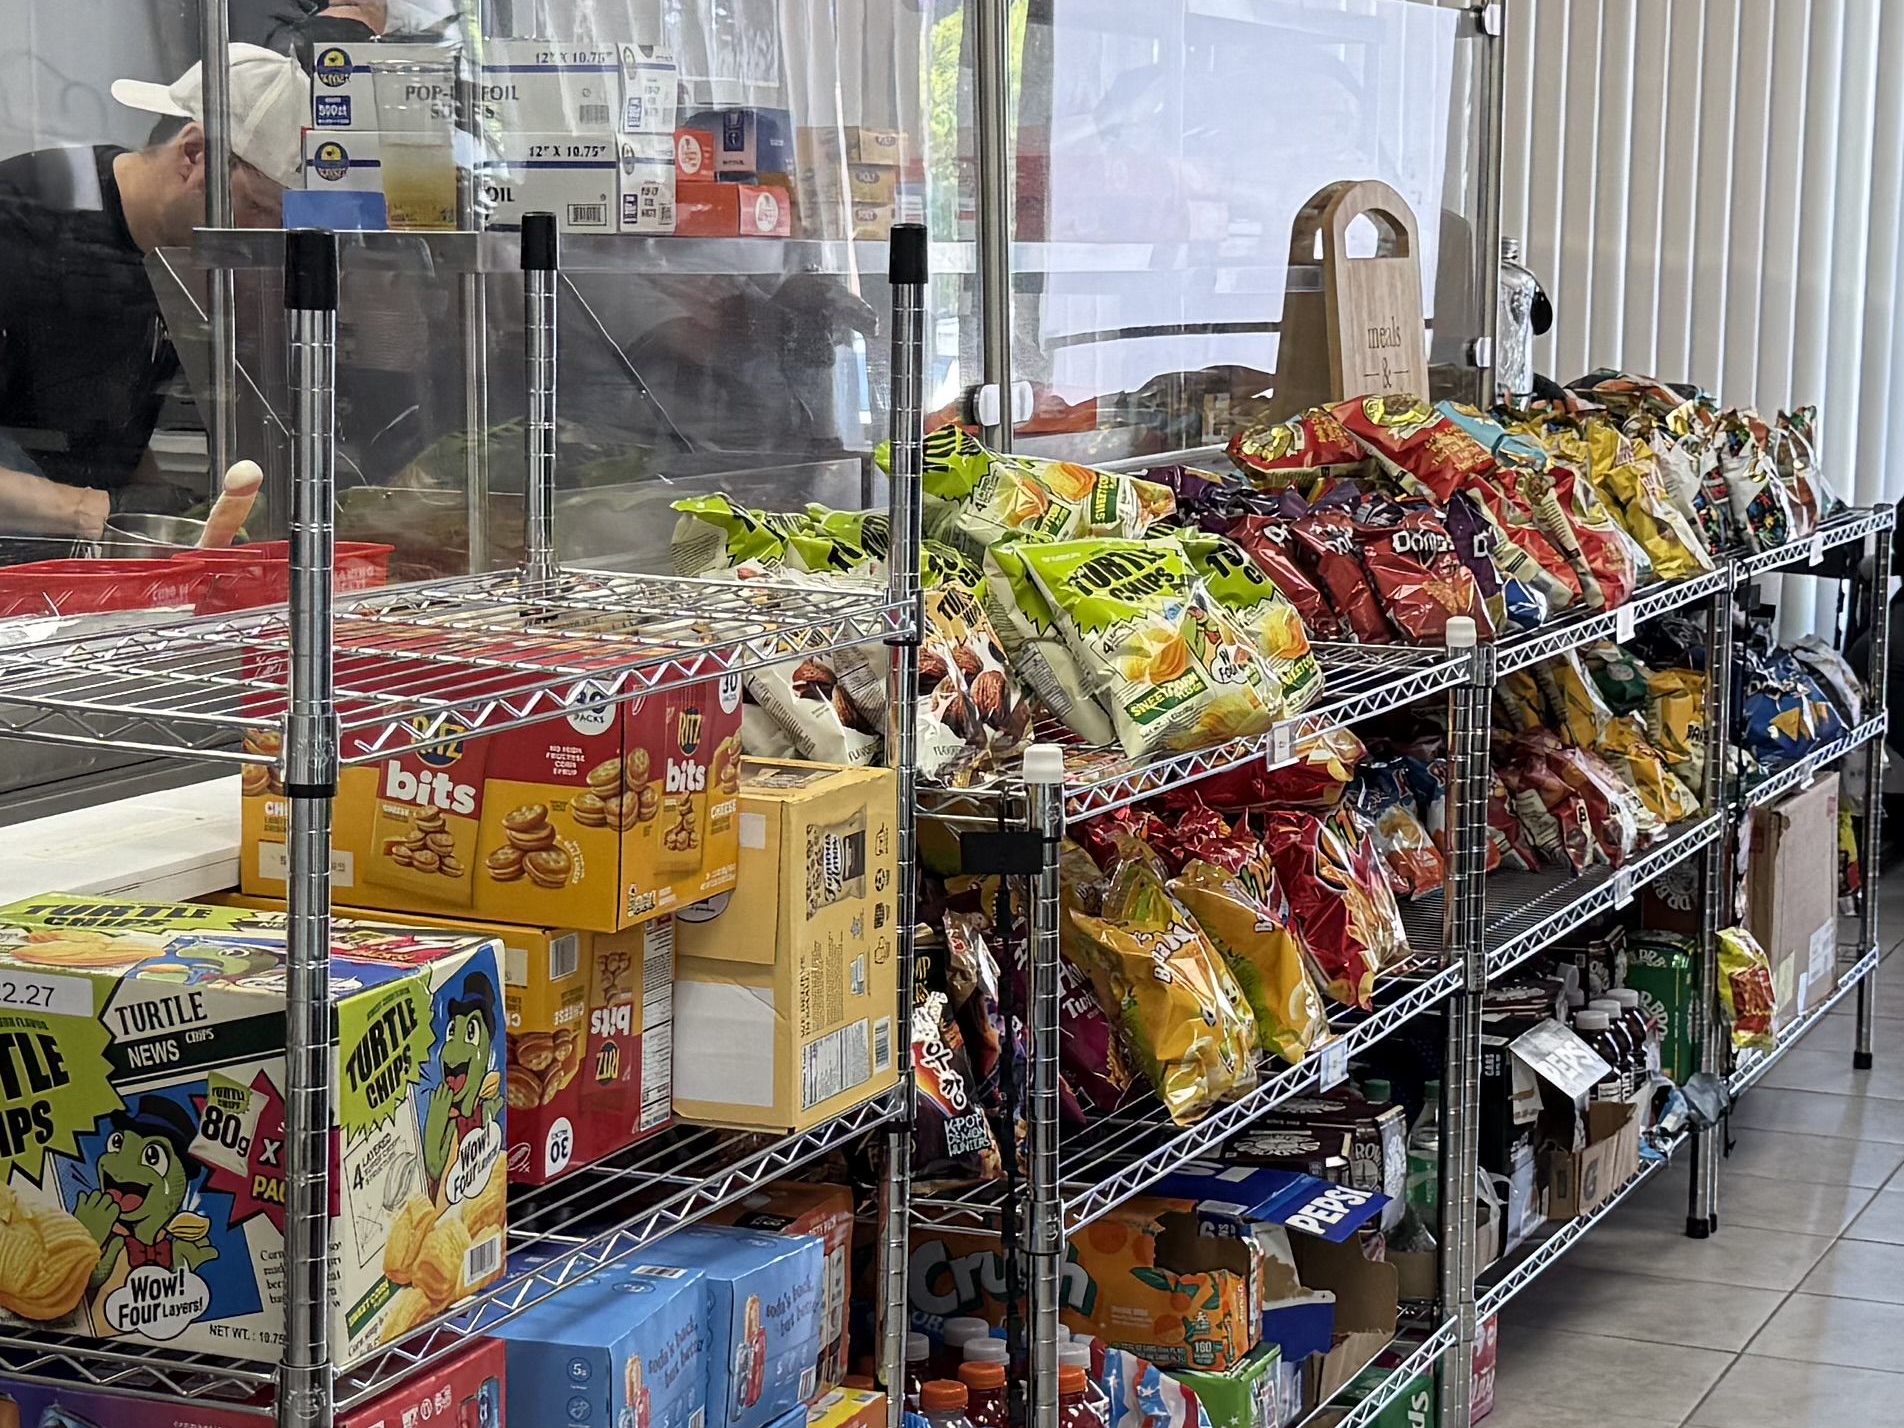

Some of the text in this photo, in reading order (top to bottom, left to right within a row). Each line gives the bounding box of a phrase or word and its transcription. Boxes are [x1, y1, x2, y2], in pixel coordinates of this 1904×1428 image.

[481, 84, 520, 101] FOIL
[485, 186, 515, 203] OIL
[1368, 316, 1401, 349] meals
[1382, 357, 1392, 388] &
[1109, 566, 1175, 603] CHIPS
[679, 712, 706, 746] RITZ
[386, 759, 477, 815] bits
[665, 757, 706, 793] bits
[23, 903, 213, 919] TURTLE
[114, 990, 208, 1037] TURTLE
[591, 1004, 633, 1038] bits
[127, 1039, 181, 1070] NEWS
[346, 996, 419, 1094] TURTLE
[365, 1043, 413, 1111] CHIPS
[596, 1048, 621, 1081] RITZ
[200, 1104, 251, 1158] 80g
[947, 1115, 983, 1134] K-POP
[550, 1136, 569, 1164] 30
[352, 1163, 365, 1191] 4
[1286, 1183, 1374, 1236] PEPSI
[129, 1268, 186, 1298] Wow!
[907, 1238, 1090, 1317] Cruh
[210, 1324, 230, 1339] NET
